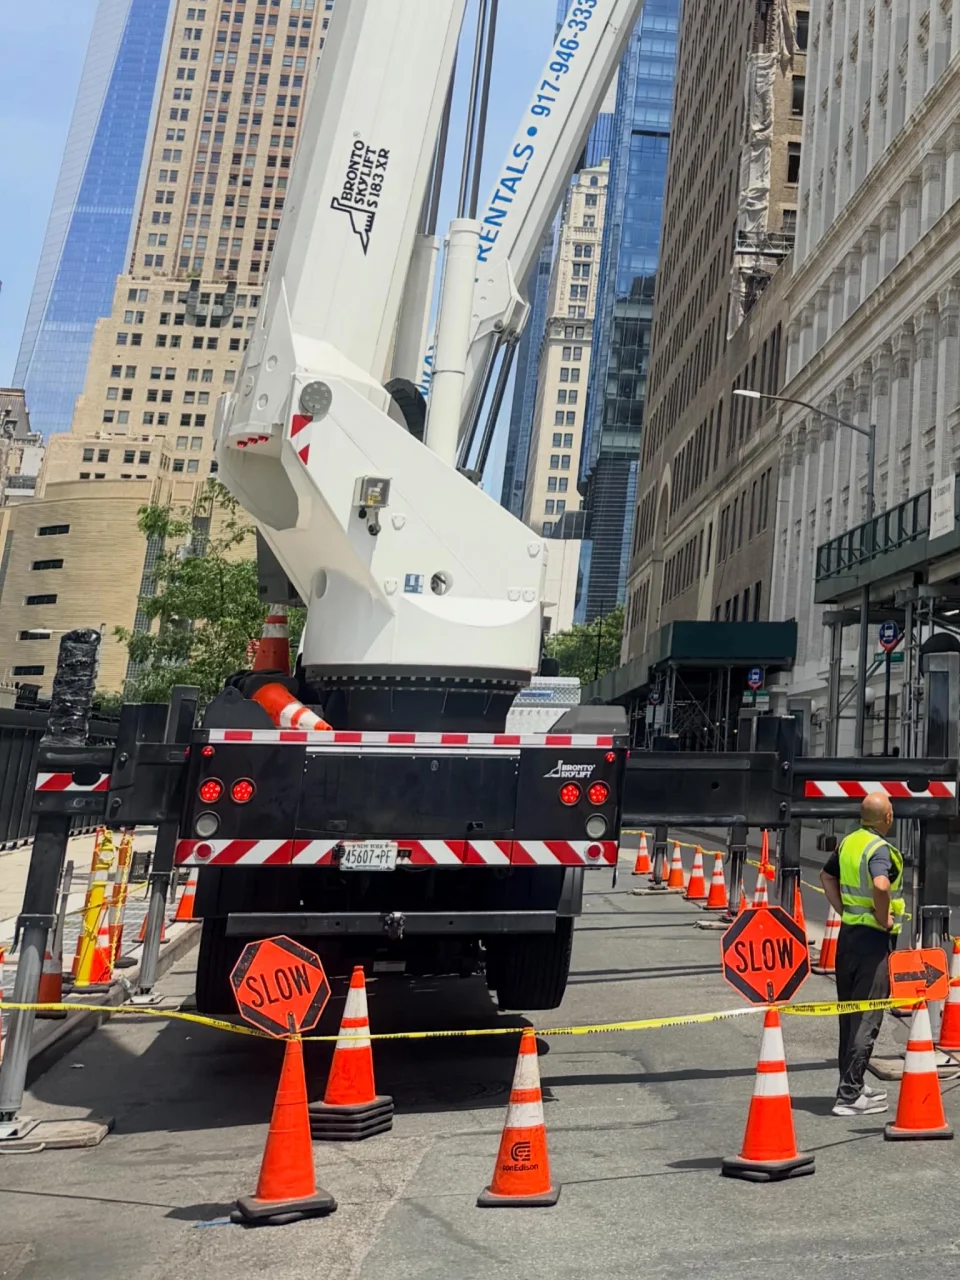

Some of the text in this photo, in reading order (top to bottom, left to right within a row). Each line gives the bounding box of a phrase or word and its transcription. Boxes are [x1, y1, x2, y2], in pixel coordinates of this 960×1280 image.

[353, 145, 377, 206] SKYLIFT
[734, 937, 794, 974] SLOW
[245, 963, 312, 1008] SLOW
